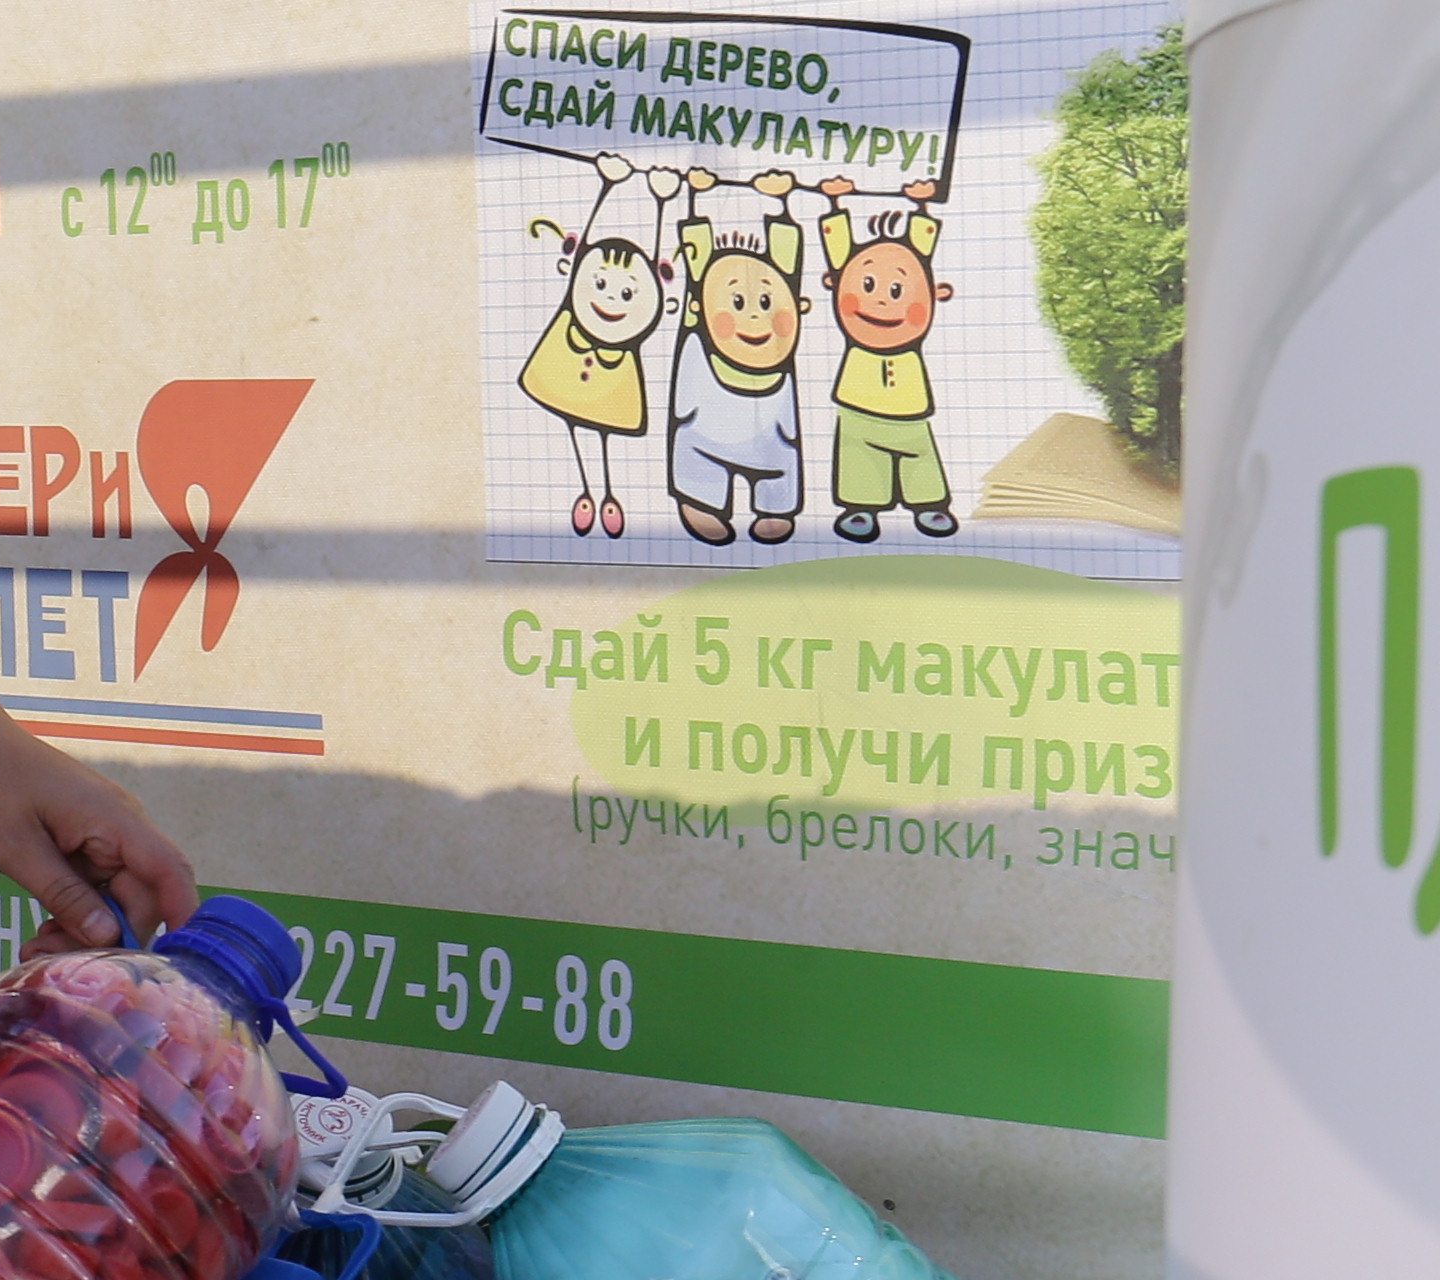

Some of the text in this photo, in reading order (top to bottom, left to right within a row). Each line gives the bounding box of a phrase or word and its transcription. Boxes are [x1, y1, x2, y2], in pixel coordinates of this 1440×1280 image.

[502, 17, 840, 103] СПАСИ ДЕРЕВО,
[497, 79, 940, 177] СДАЙ МАКУЛАТУРУ!
[61, 187, 83, 238] с
[191, 177, 250, 244] до
[502, 609, 1180, 718] Сдай 5 кг макулат
[624, 716, 1173, 810] и получи приз
[572, 775, 1177, 874] (ручки, брелоки, знач
